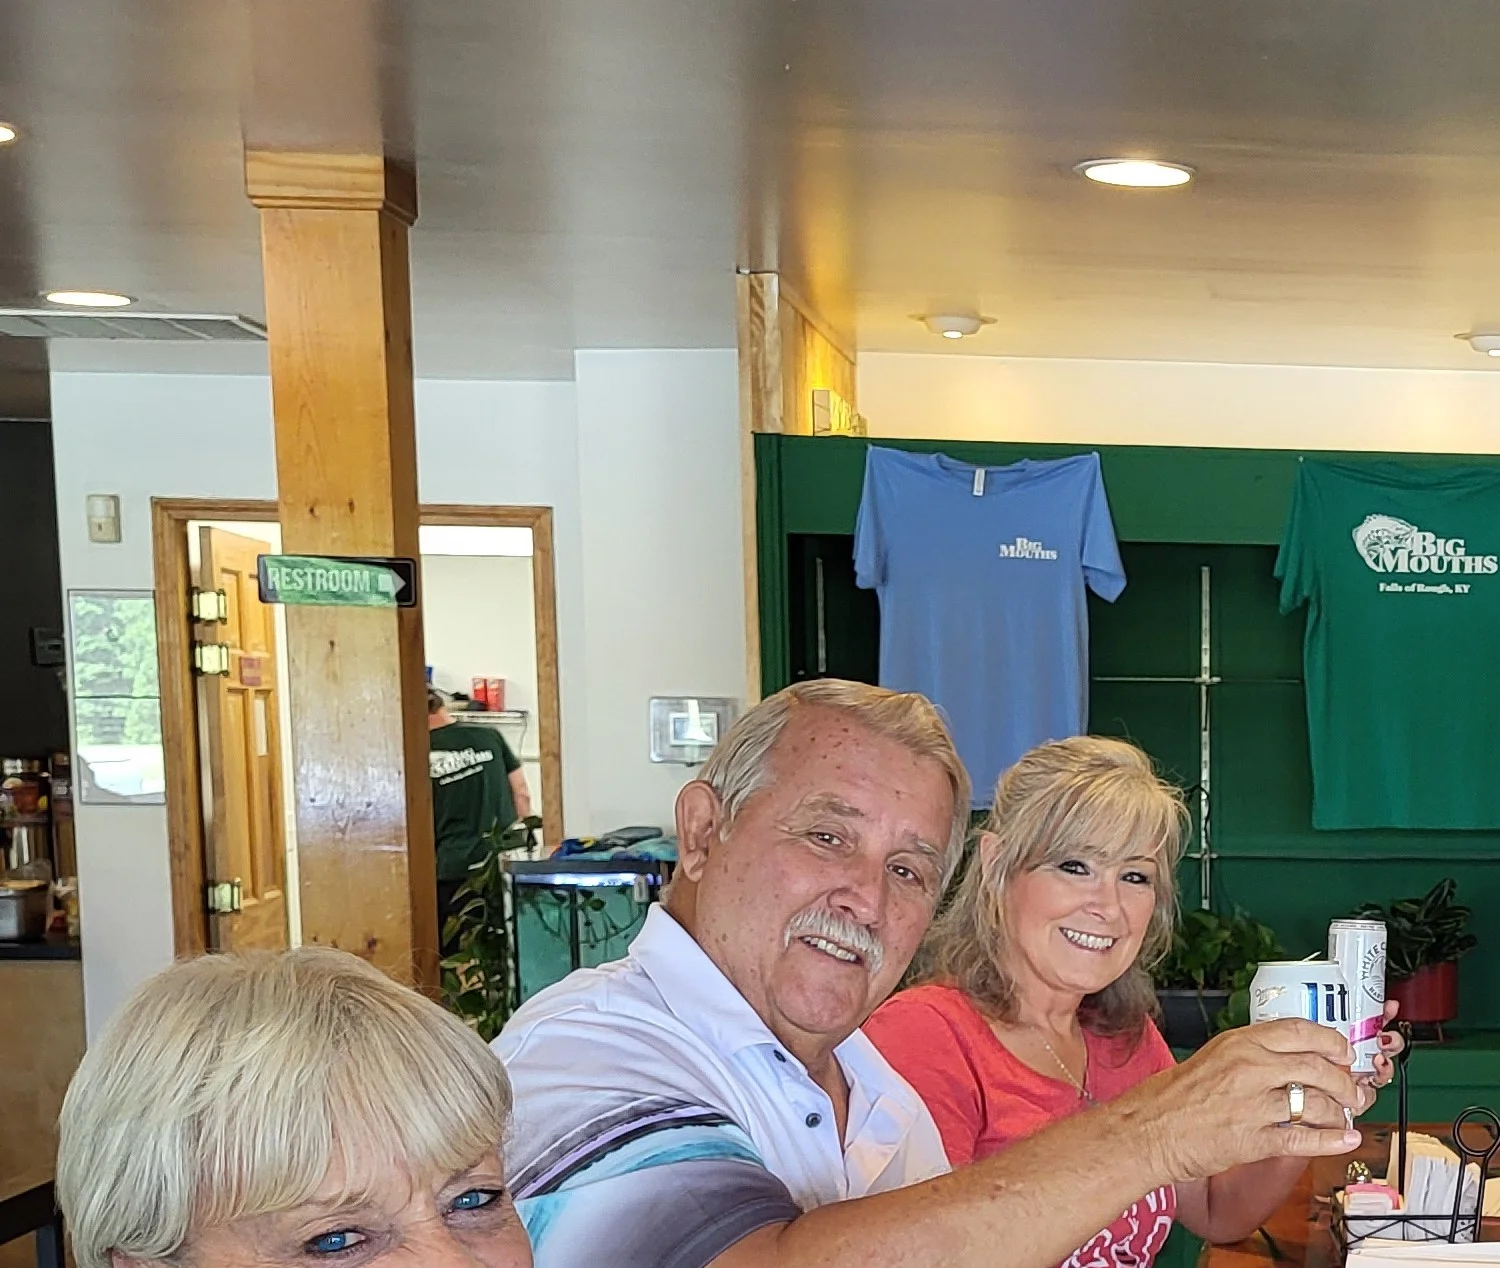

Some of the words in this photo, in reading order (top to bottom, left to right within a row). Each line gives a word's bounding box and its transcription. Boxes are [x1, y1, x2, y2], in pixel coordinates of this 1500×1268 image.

[267, 567, 371, 593] RESTROOM
[1378, 582, 1403, 593] Falls
[1404, 583, 1417, 593] of
[1454, 584, 1471, 594] KY
